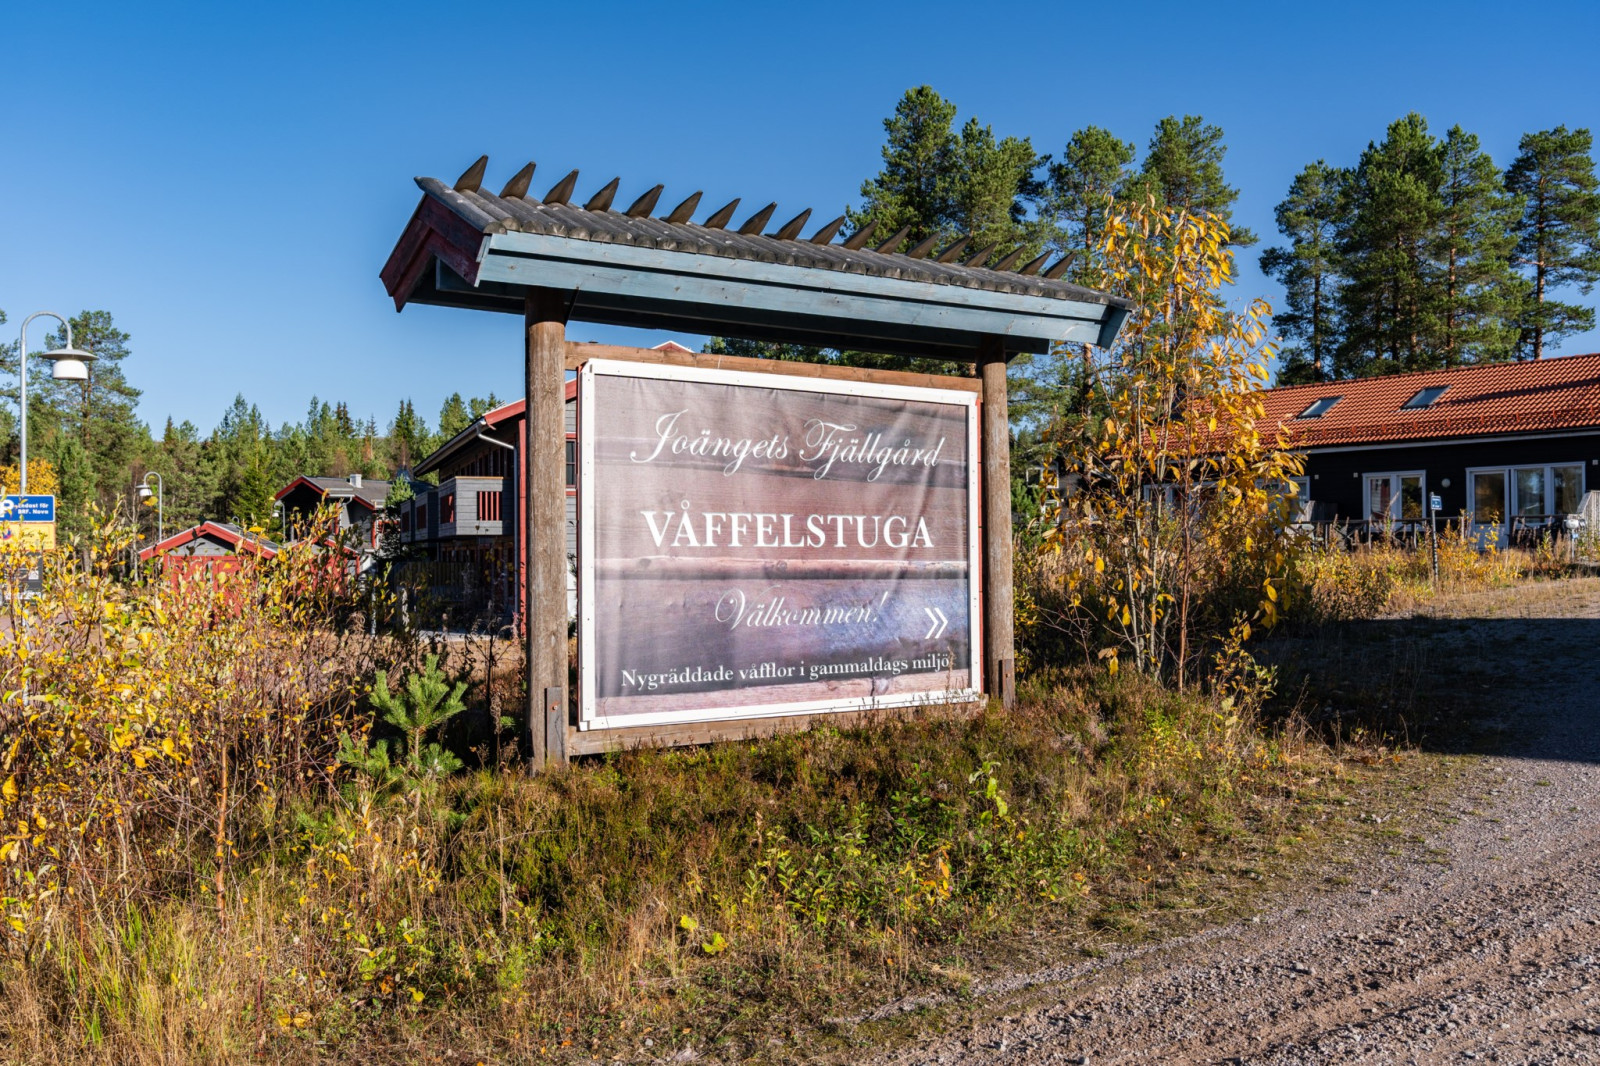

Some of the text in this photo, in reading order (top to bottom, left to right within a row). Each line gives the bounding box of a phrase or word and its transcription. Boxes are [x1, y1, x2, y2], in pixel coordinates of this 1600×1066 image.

[629, 408, 945, 482] Joängets Fjällgård
[640, 499, 934, 549] VÅFFELSTUGA
[715, 584, 889, 631] Välkommen!
[621, 652, 950, 691] Nygräddade våfflor i gammaldags miljö
